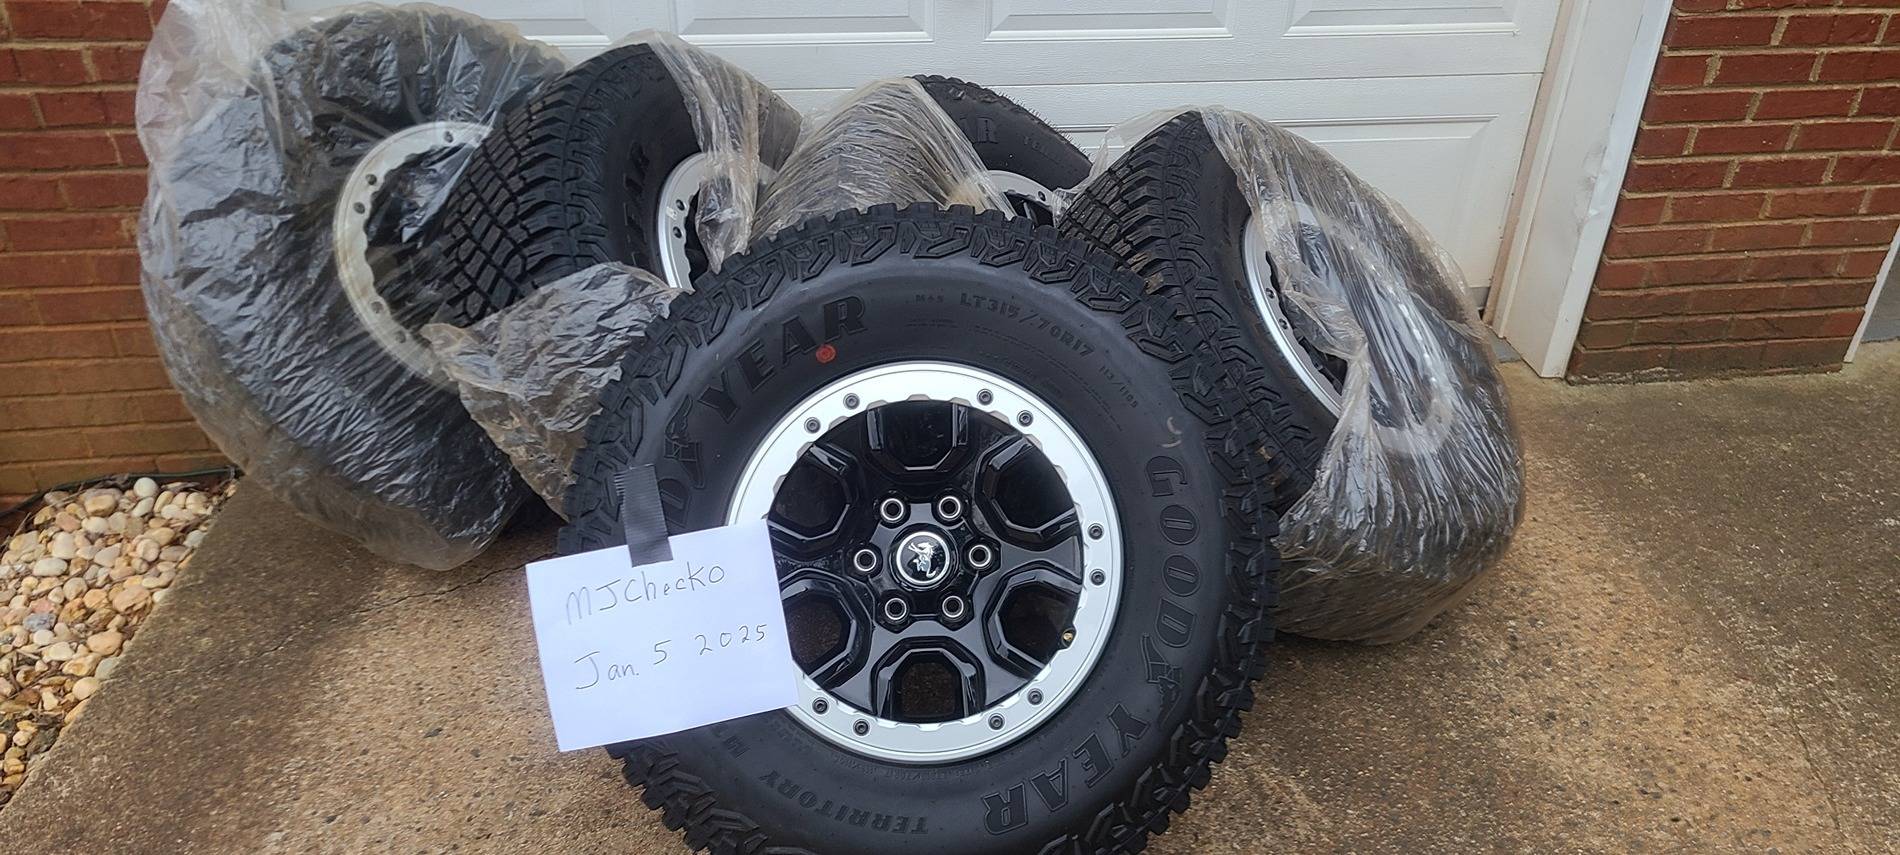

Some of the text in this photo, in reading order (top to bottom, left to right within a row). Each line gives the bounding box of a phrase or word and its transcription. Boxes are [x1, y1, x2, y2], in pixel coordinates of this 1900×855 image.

[959, 291, 1095, 358] LT315/70R17
[698, 296, 868, 424] YEAR
[574, 624, 768, 690] Jan. 5 2025
[758, 769, 930, 835] TERRITORY
